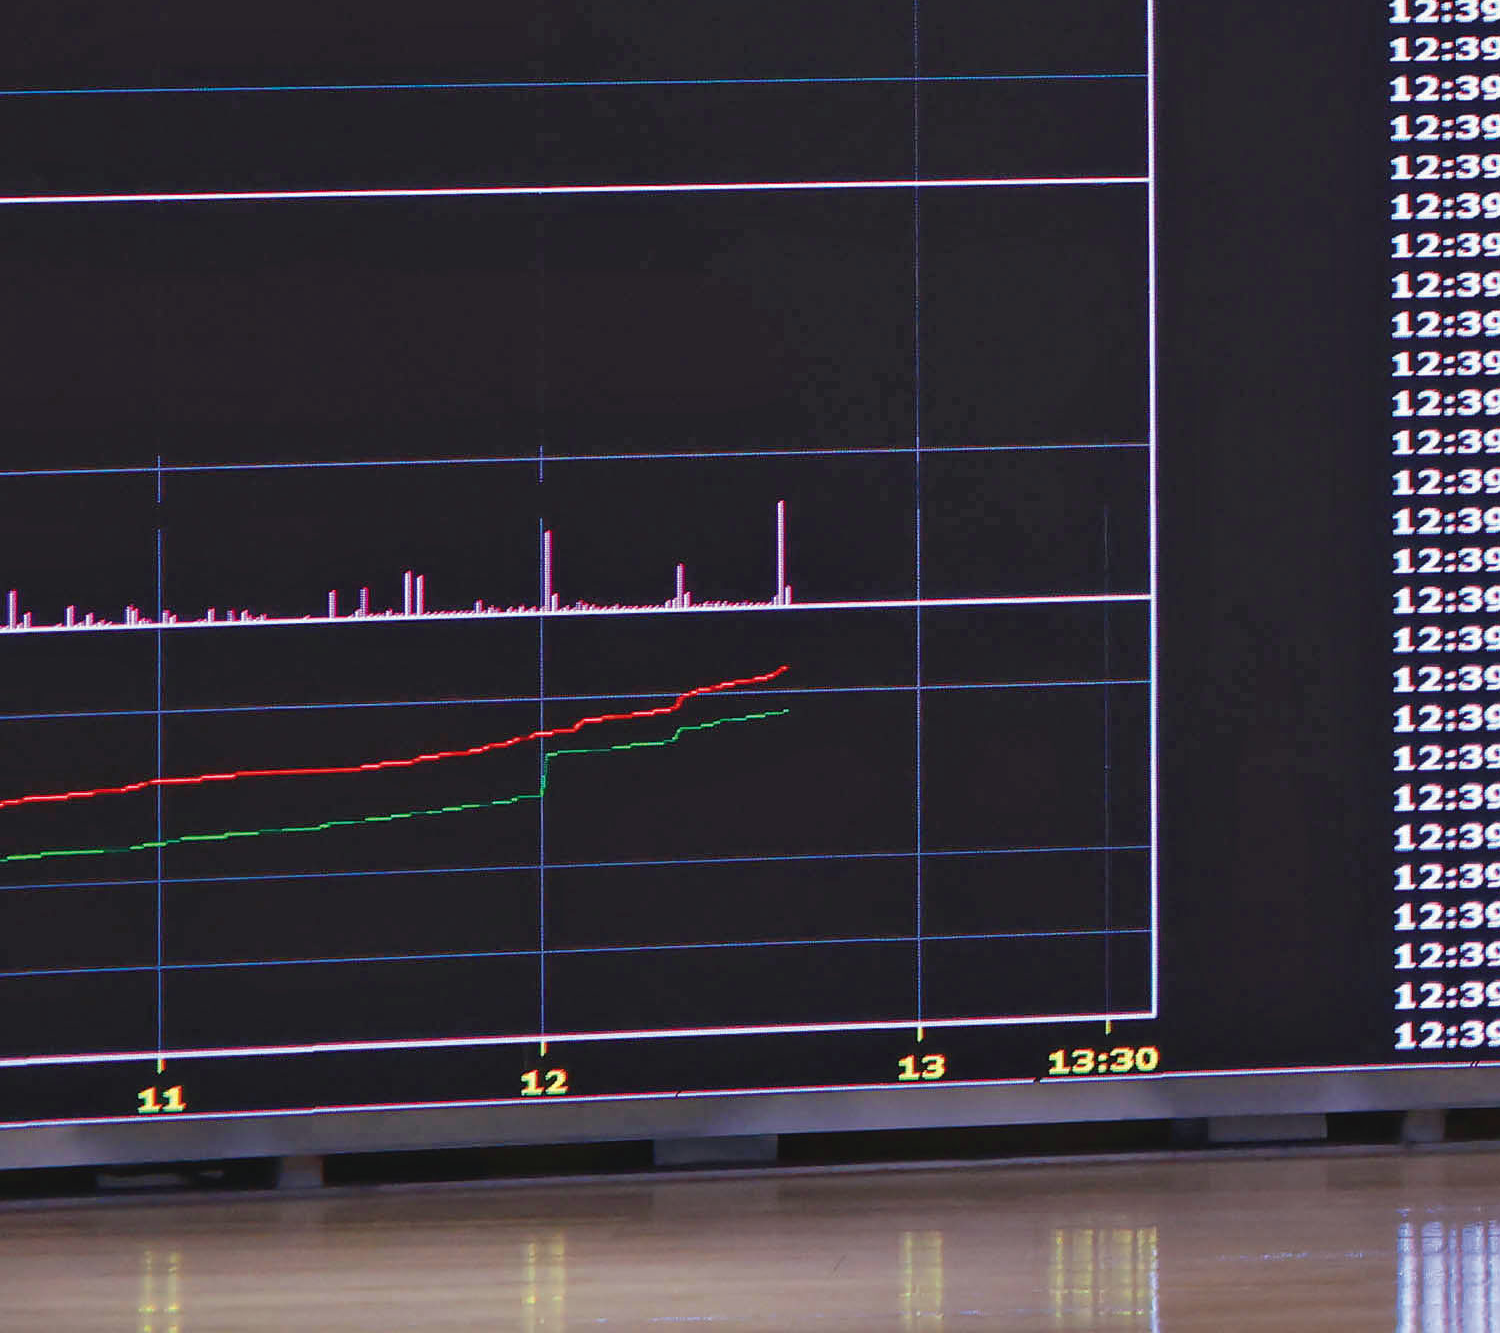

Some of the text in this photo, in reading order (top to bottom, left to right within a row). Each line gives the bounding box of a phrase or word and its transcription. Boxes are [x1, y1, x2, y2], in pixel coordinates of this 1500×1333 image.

[139, 1047, 1159, 1112] 11 12 13 13:30
